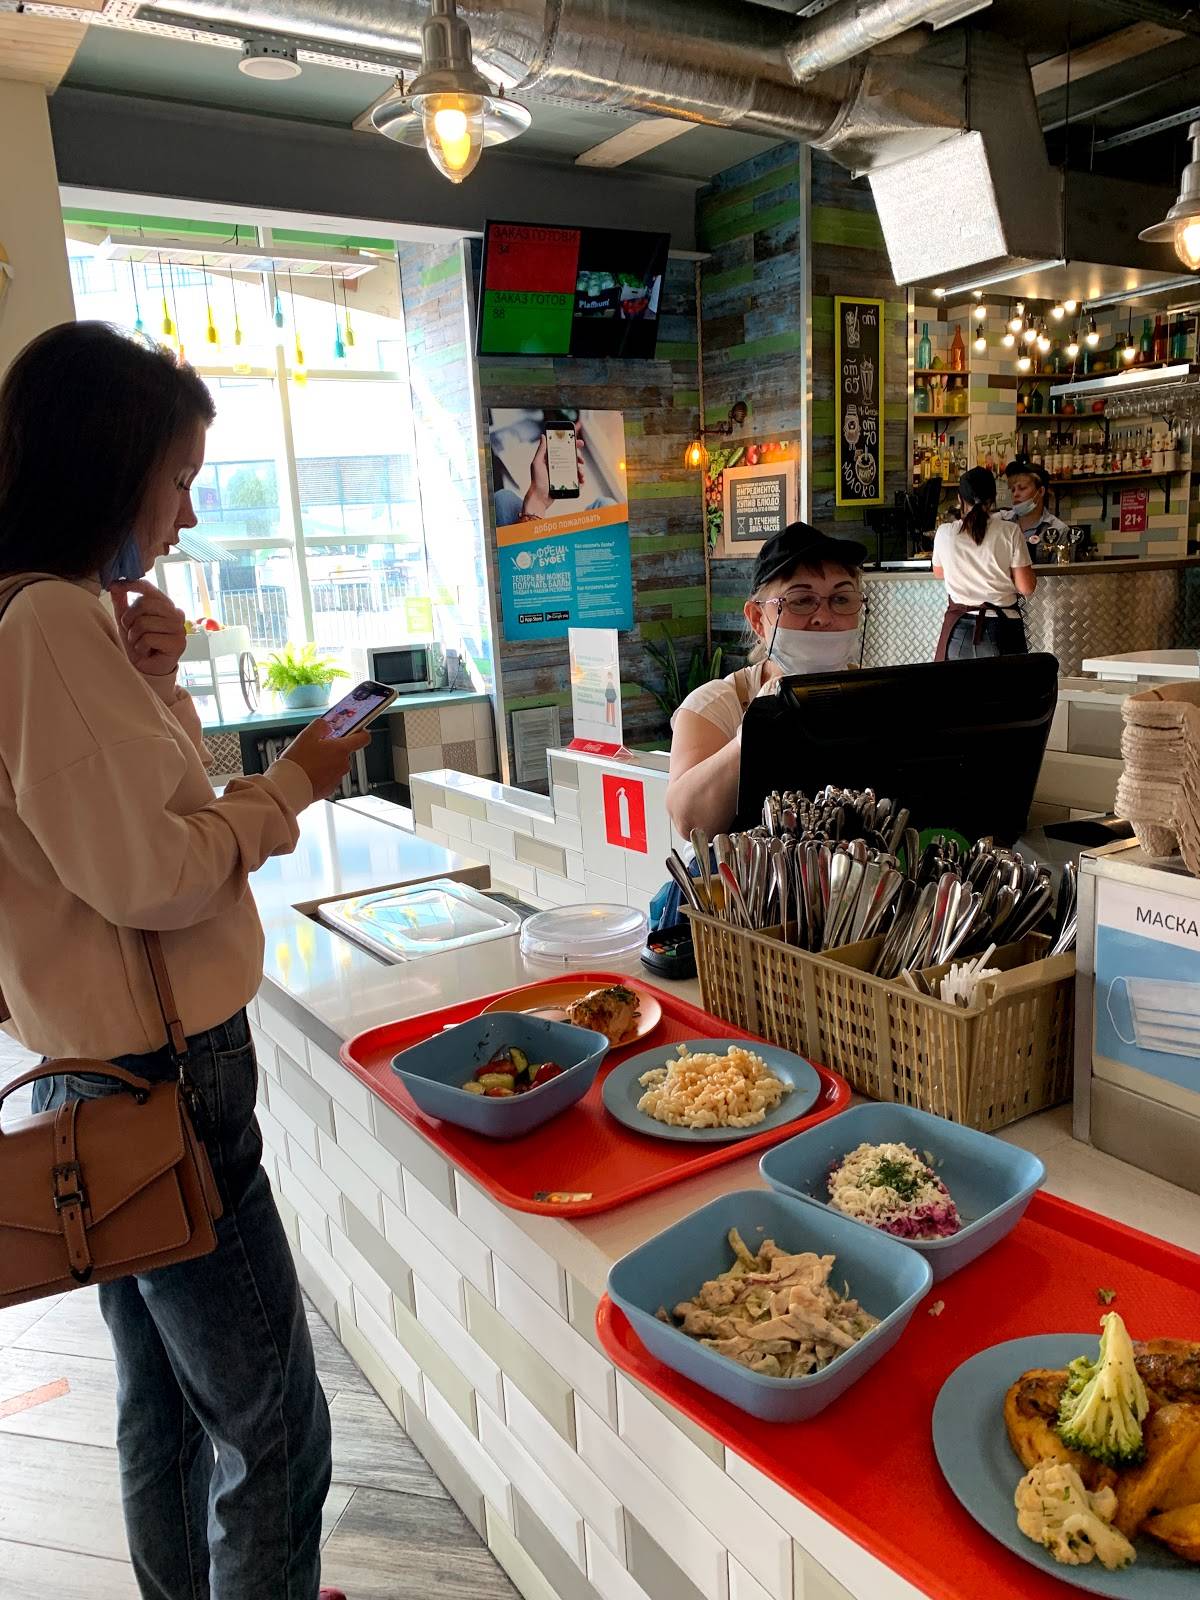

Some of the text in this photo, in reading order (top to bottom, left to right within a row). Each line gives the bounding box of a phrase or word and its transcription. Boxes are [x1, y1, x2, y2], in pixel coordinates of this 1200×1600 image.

[494, 226, 529, 240] ЗАКАЗ
[494, 293, 567, 306] ЗАКАЗ ГОТОВ
[845, 376, 860, 394] 65
[863, 431, 877, 445] 70
[736, 499, 756, 508] КУПИВ
[534, 514, 600, 534] добро пожаловать
[749, 516, 780, 525] В ТЕЧЕНИЕ
[1124, 514, 1142, 525] 21+
[749, 524, 780, 533] ДВУХ ЧАСОВ
[540, 553, 566, 567] БУФЕТ
[512, 574, 535, 583] ТЕПЕРЬ
[512, 580, 547, 591] ПОЛУЧАТЬ
[1136, 906, 1199, 937] МАСКА
